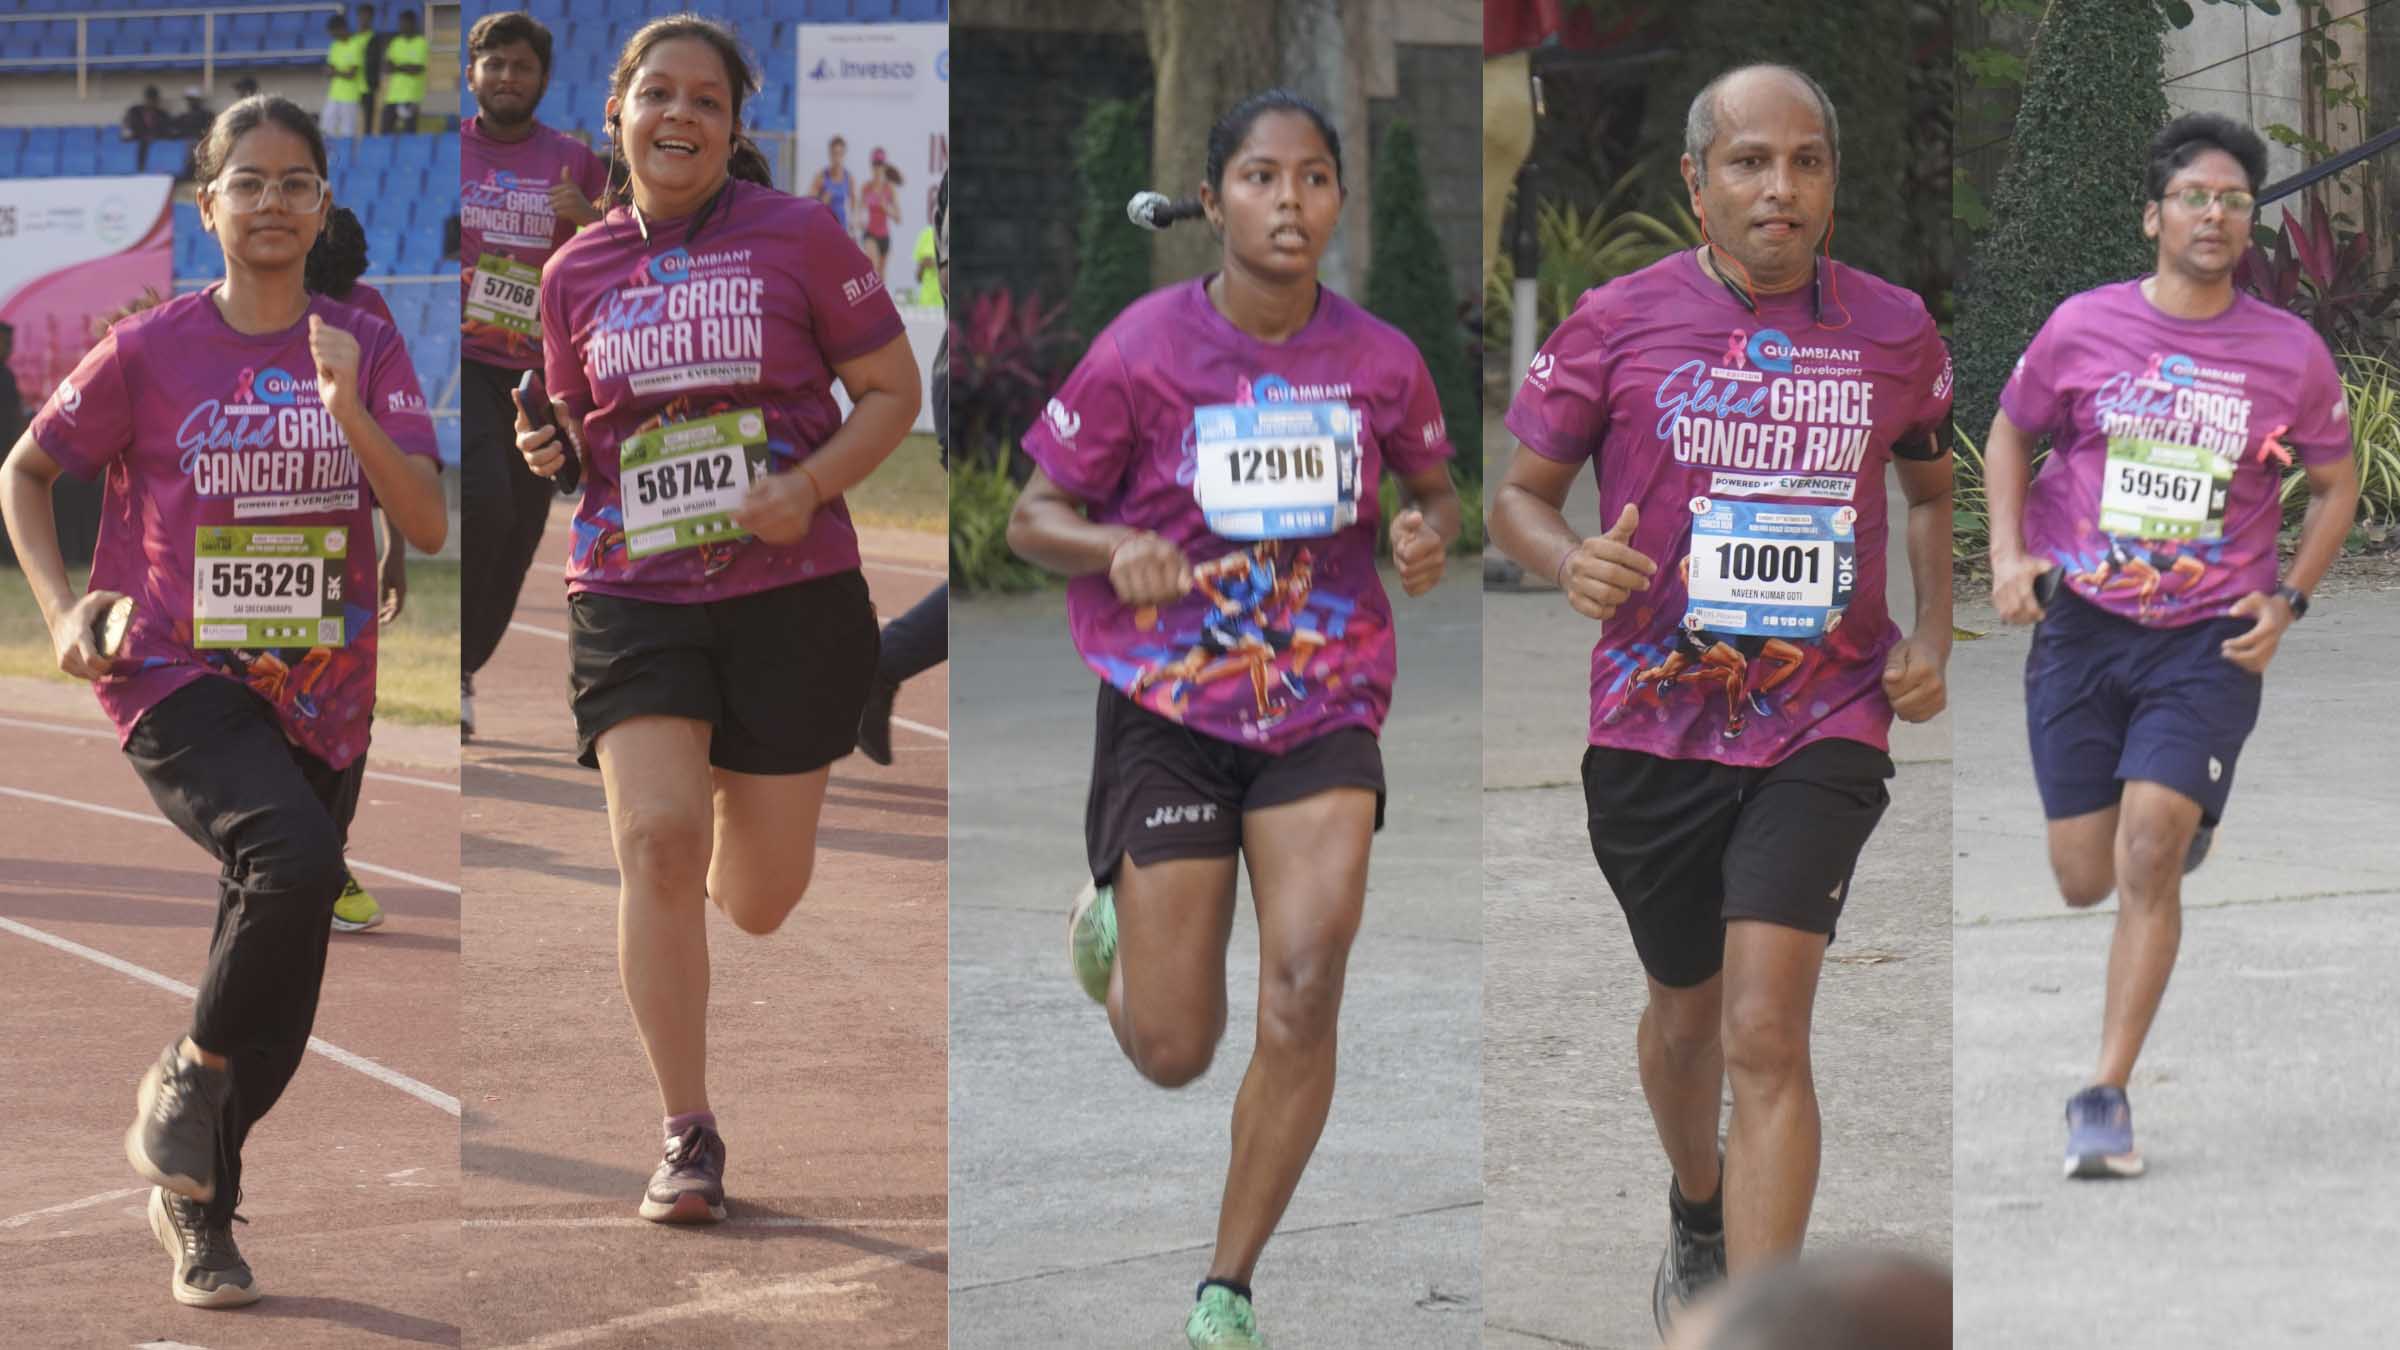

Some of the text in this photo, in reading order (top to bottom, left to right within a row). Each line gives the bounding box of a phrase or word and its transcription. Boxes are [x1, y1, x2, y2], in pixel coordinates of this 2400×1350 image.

[523, 214, 557, 239] RUN
[664, 249, 752, 271] QUAMBIANT
[483, 276, 536, 307] 57768
[668, 276, 765, 322] GRACE
[592, 316, 763, 381] CANCER RUN
[1764, 345, 1861, 362] QUAMBIANT
[1793, 363, 1863, 377] Developers
[1656, 359, 1874, 440] Global GRACE
[2174, 387, 2253, 434] GRACE
[176, 399, 276, 475] Global
[1672, 415, 1872, 473] CANCER RUN
[2196, 425, 2249, 462] RUN
[194, 449, 360, 496] CANCER RUN
[636, 454, 737, 506] 58742
[1224, 445, 1325, 484] 12916
[1715, 477, 1761, 488] POWERED
[1779, 477, 1852, 492] EVERNORTH
[2120, 467, 2203, 504] 59567
[211, 562, 315, 598] 55329
[1715, 542, 1820, 584] 10001
[1838, 555, 1854, 593] 10K
[327, 575, 341, 600] 5K
[1731, 588, 1759, 599] NAVEEN
[1760, 589, 1786, 600] KUMAR
